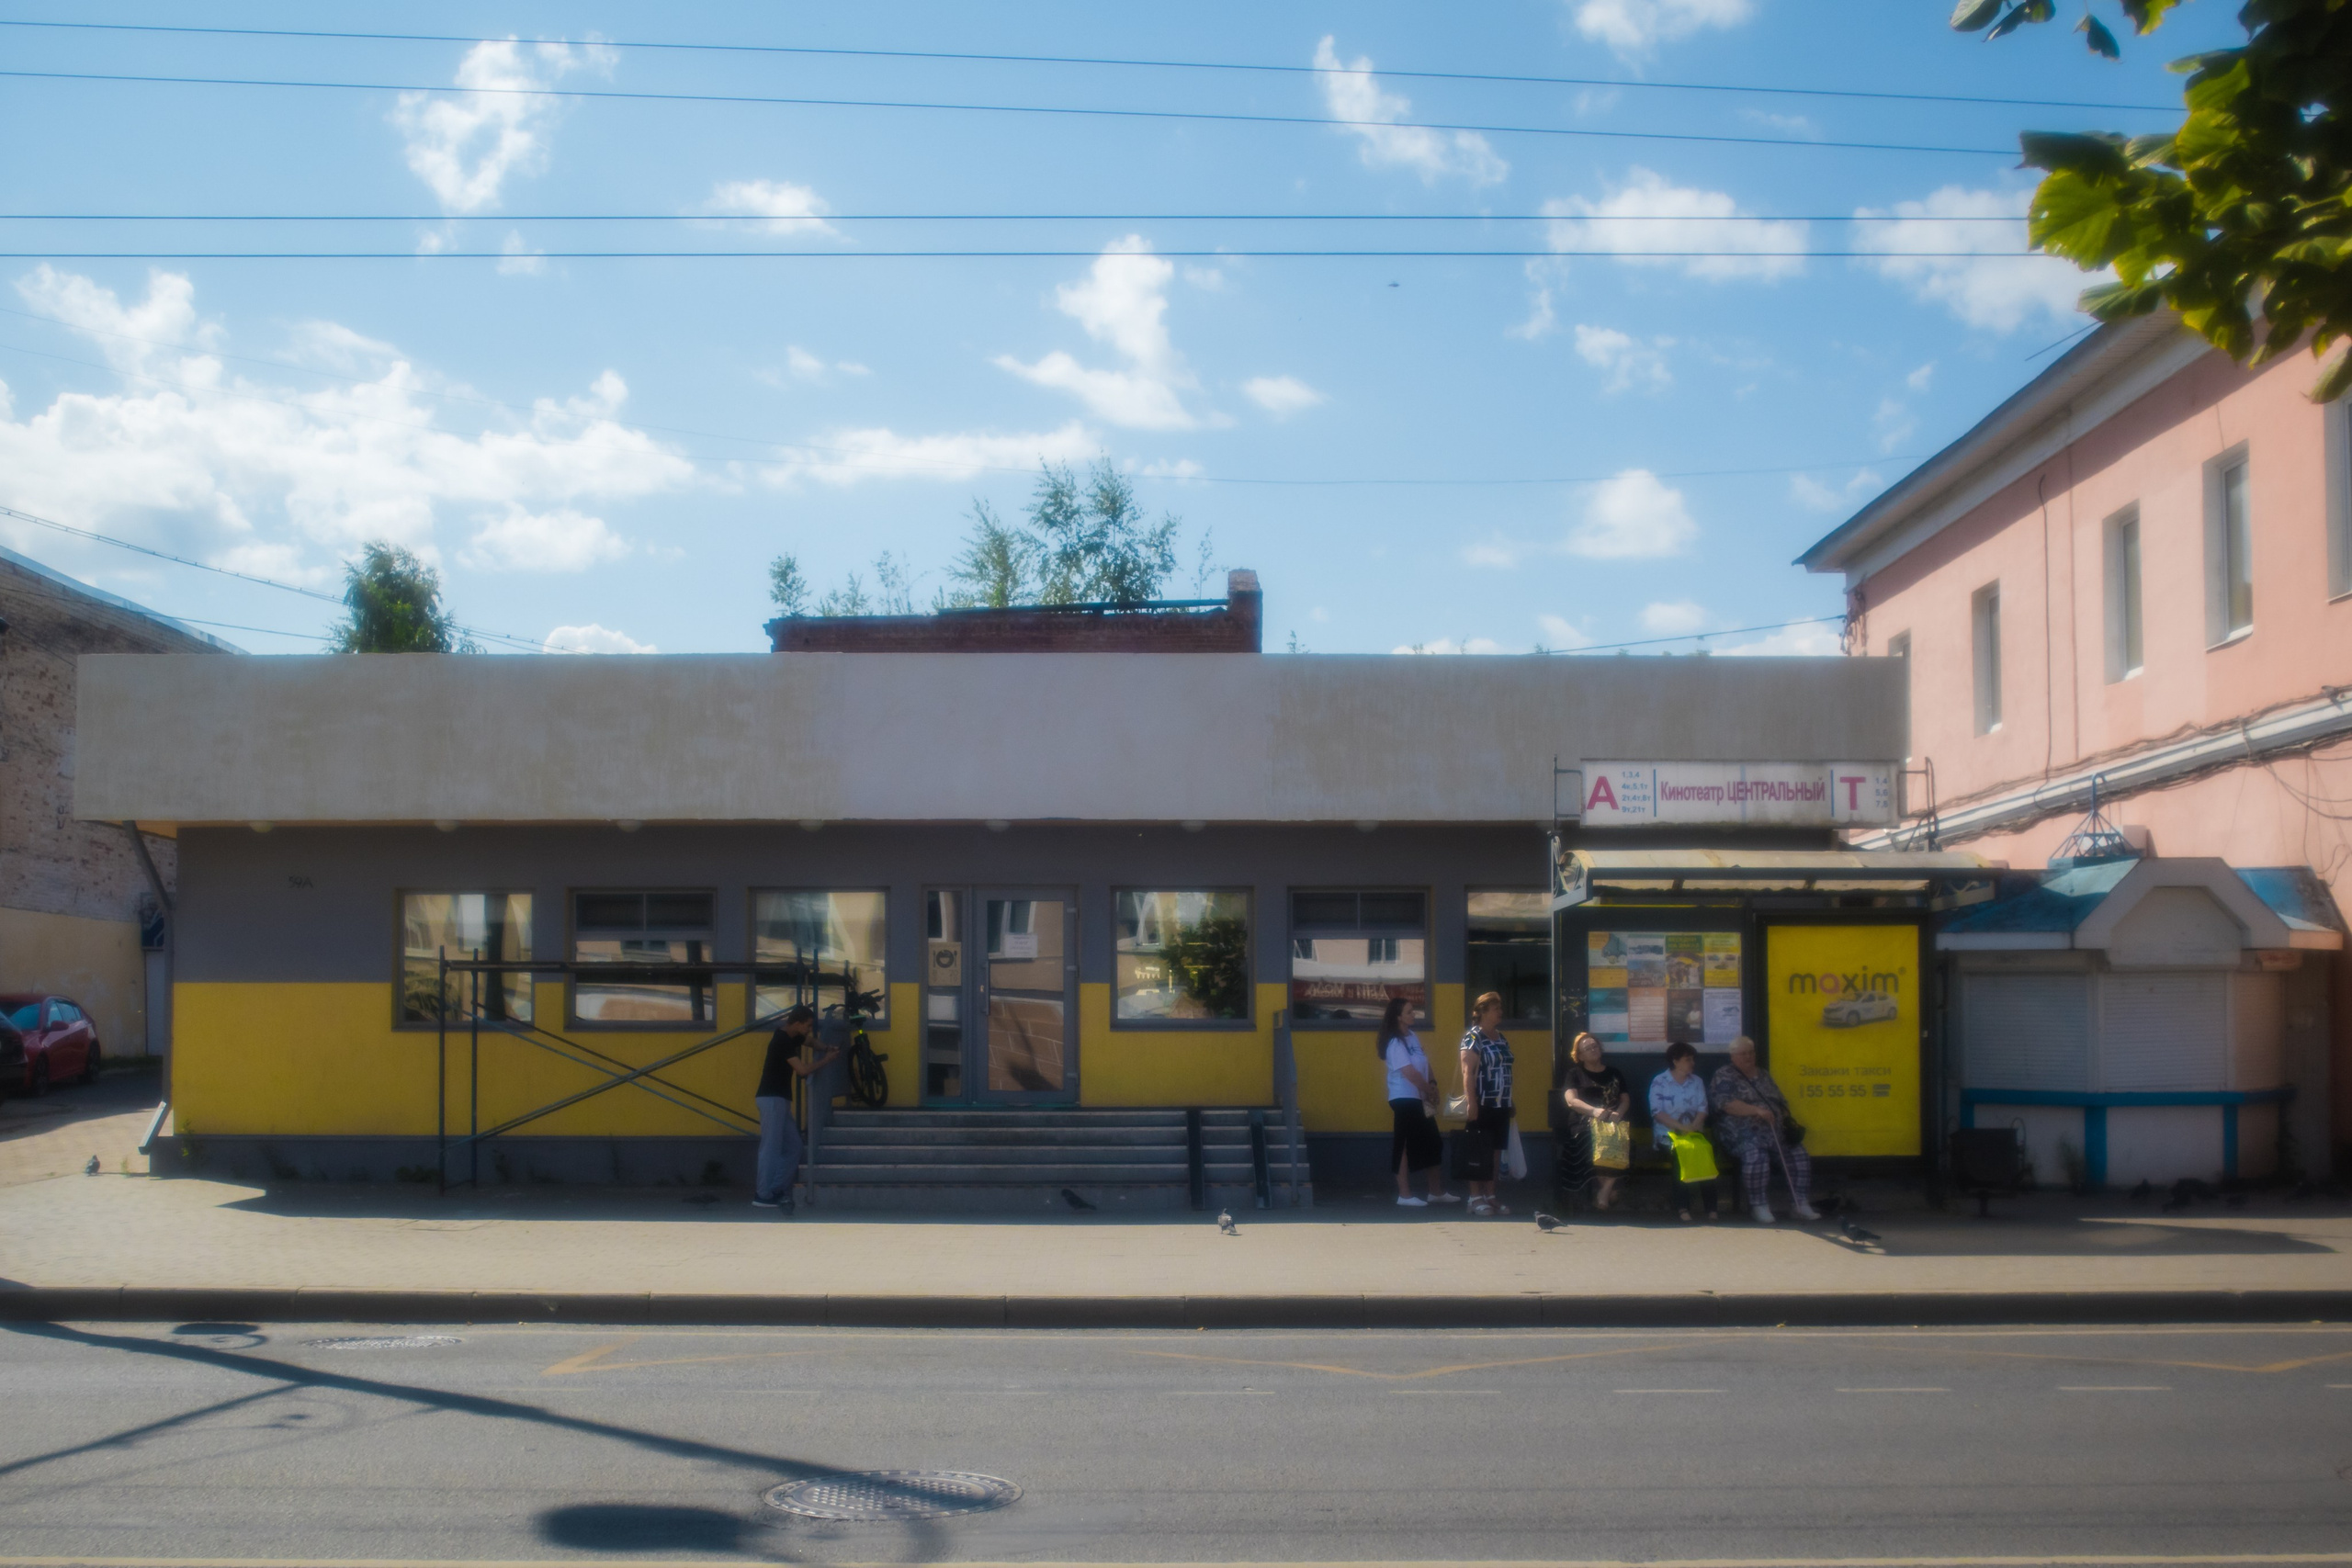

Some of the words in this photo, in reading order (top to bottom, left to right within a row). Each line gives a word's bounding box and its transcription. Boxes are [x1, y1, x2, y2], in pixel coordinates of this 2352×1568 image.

[1587, 776, 1620, 809] А
[1660, 780, 1724, 806] Кинотеатр
[1727, 775, 1826, 805] ЦЕНТРАЛЬНЫЙ
[1839, 776, 1866, 810] Т
[1789, 965, 1900, 995] maxim
[1799, 1065, 1850, 1077] Закажи
[1854, 1066, 1891, 1077] такси
[1806, 1084, 1824, 1098] 55
[1827, 1084, 1845, 1098] 55
[1849, 1084, 1867, 1098] 55
